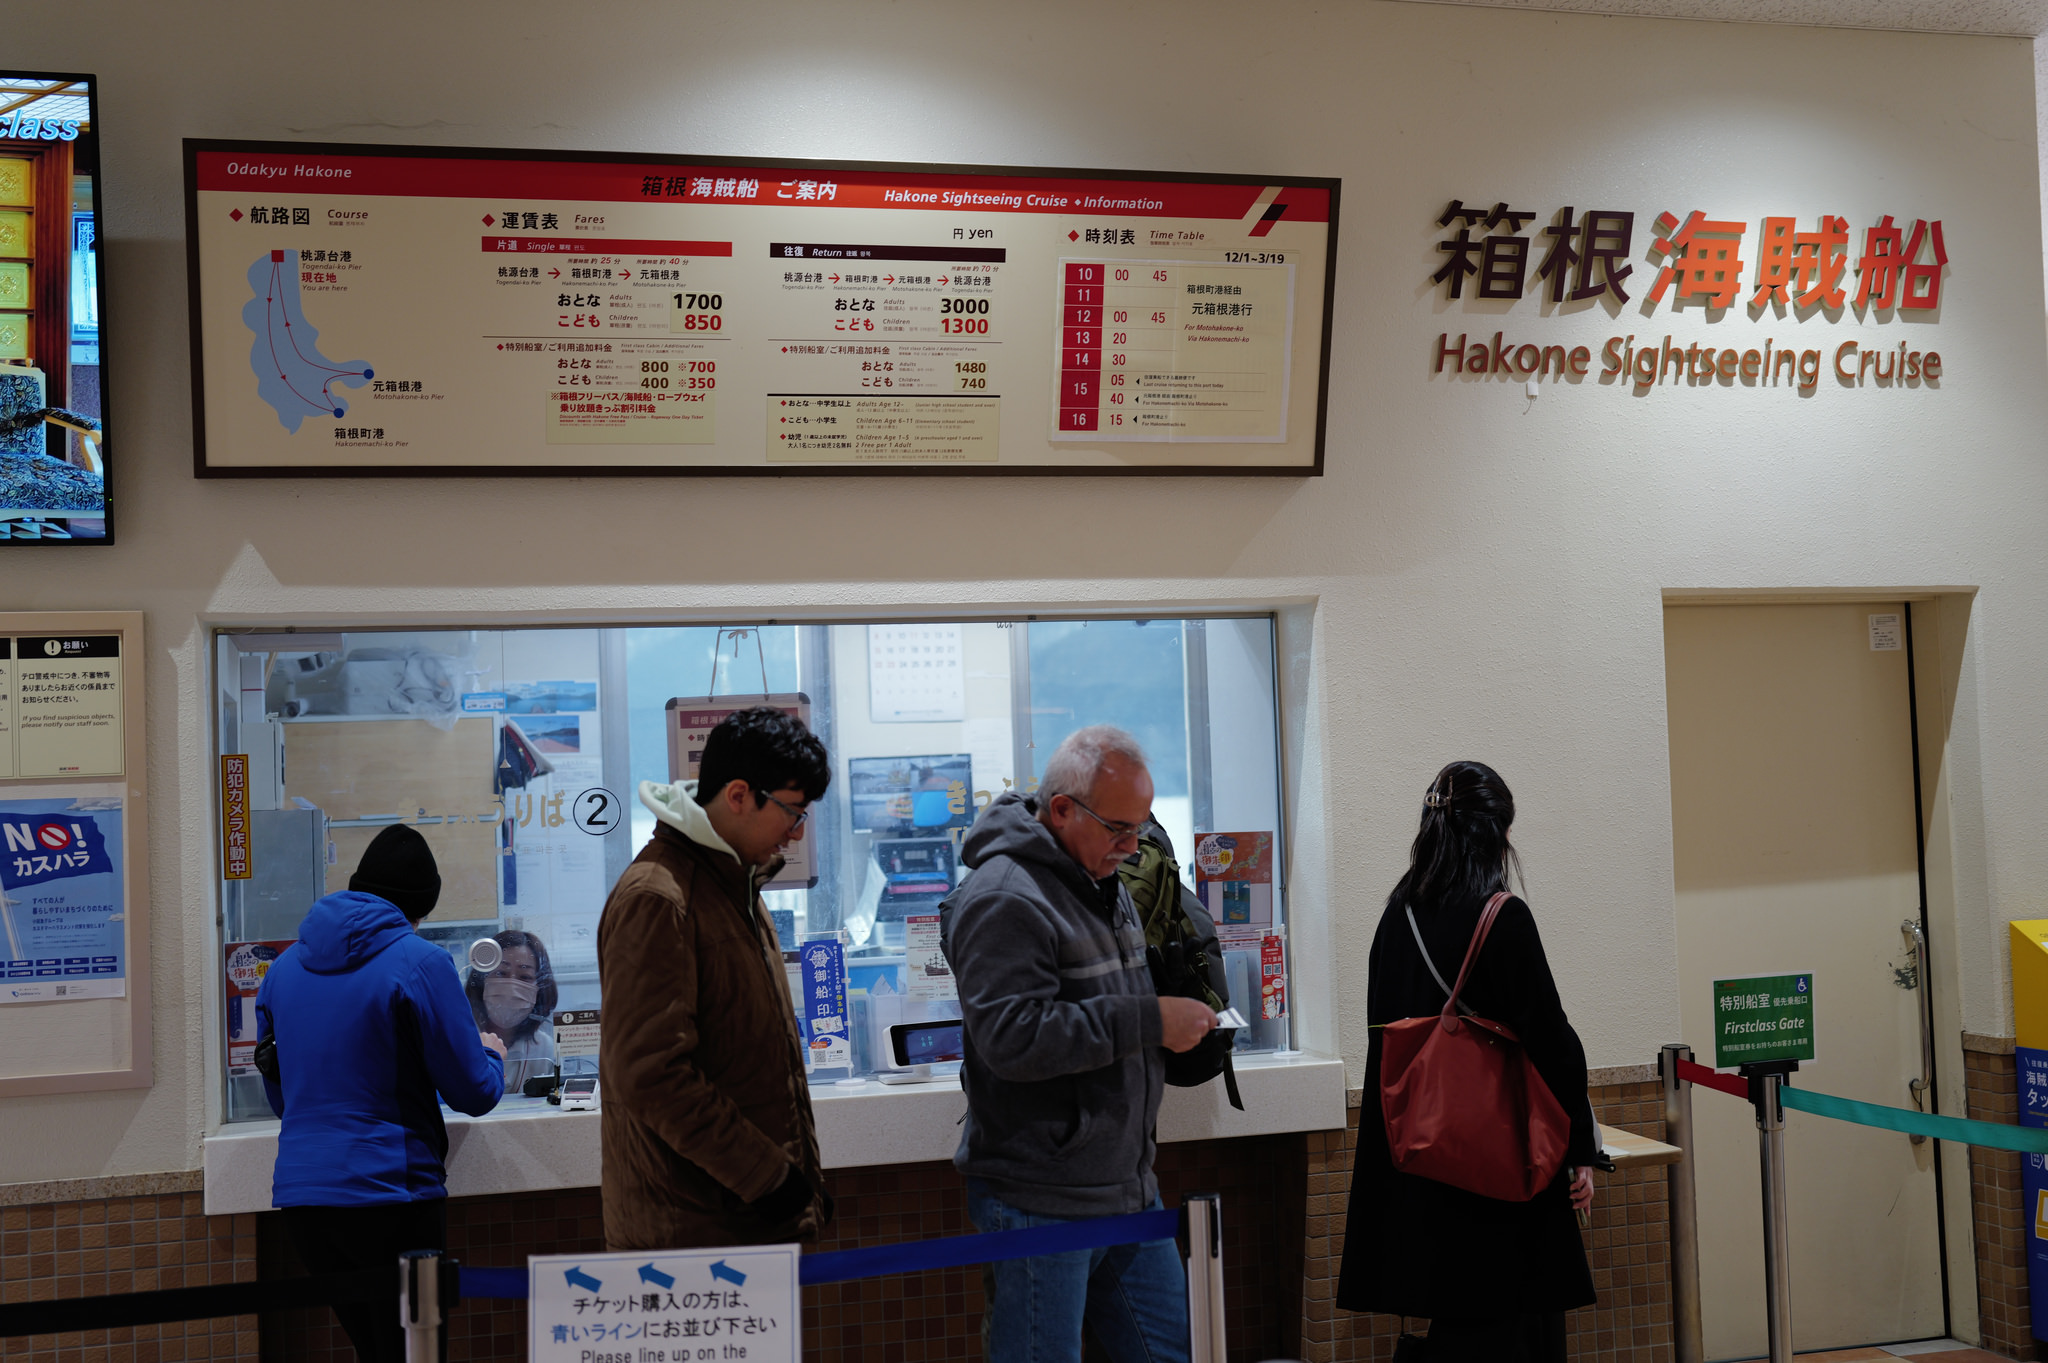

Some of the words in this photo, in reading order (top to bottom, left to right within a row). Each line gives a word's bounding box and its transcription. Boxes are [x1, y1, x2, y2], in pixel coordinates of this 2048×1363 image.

[227, 162, 288, 178] Odakyu
[293, 164, 353, 178] Hakone
[641, 175, 760, 200] 箱根海賊船
[775, 179, 838, 202] ご案内
[884, 188, 938, 205] Hakone
[941, 190, 1022, 209] Sightseeing
[1026, 193, 1069, 208] Cruise
[1083, 195, 1164, 211] Information
[249, 206, 311, 226] 航路図
[327, 208, 369, 220] Course
[501, 211, 559, 230] 運賃表
[574, 213, 605, 224] Fares
[952, 228, 964, 240] 円
[968, 228, 994, 241] yen
[1085, 228, 1136, 246] 時刻表
[1149, 230, 1174, 240] Time
[1177, 231, 1206, 241] Table
[497, 240, 518, 251] 片道
[526, 242, 556, 252] Single
[784, 246, 804, 257] 往復
[812, 248, 842, 258] Return
[301, 250, 352, 262] 桃源台港
[600, 256, 612, 265] 25
[668, 257, 680, 265] 40
[1224, 251, 1286, 265] 12/1~3/19
[1431, 199, 1949, 311] 箱根海賊船
[302, 263, 347, 272] Togendai-ko
[348, 263, 363, 271] Pier
[498, 267, 540, 278] 桃源台港
[571, 268, 612, 280] 箱根町港
[640, 269, 680, 281] 元箱根港
[301, 271, 338, 283] 現在地
[784, 272, 823, 283] 桃源台港
[845, 274, 879, 284] 箱根町港
[898, 275, 932, 285] 元箱根港
[953, 276, 992, 287] 桃源台港
[1078, 268, 1093, 281] 10
[1114, 269, 1130, 282] 00
[1152, 270, 1168, 282] 45
[302, 284, 315, 292] You
[330, 284, 349, 292] here
[1187, 284, 1242, 296] 箱根町港経由
[557, 293, 601, 308] おとな
[1077, 288, 1091, 302] 11
[672, 293, 724, 311] 1700
[834, 298, 876, 312] おとな
[883, 298, 906, 306] Adults
[940, 298, 990, 315] 3000
[1191, 302, 1253, 317] 元箱根港行
[557, 313, 601, 328] こども
[684, 314, 723, 332] 850
[1077, 310, 1091, 323] 12
[1113, 311, 1128, 323] 00
[1151, 312, 1166, 324] 45
[834, 318, 875, 332] こども
[882, 318, 911, 326] Children
[940, 318, 989, 334] 1300
[1196, 324, 1244, 332] Motohakone-ko
[1076, 332, 1090, 345] 13
[1112, 333, 1127, 345] 20
[505, 342, 613, 353] 特別船室/ご利用追加料金
[557, 358, 592, 370] おとな
[1075, 353, 1090, 366] 14
[1111, 354, 1126, 366] 30
[1436, 330, 1591, 377] Hakone
[1600, 333, 1823, 389] Sightseeing
[1833, 339, 1943, 381] Cruise
[640, 361, 669, 373] 800
[861, 361, 895, 372] おとな
[954, 362, 987, 374] 1480
[373, 380, 423, 393] 元箱根港
[557, 374, 592, 386] こども
[640, 377, 669, 389] 400
[861, 377, 894, 388] こども
[960, 378, 987, 390] 740
[1074, 382, 1088, 395] 15
[1111, 374, 1125, 387] 05
[373, 393, 430, 401] Motohakone-ko
[1110, 393, 1124, 405] 40
[855, 417, 883, 425] Children
[1072, 413, 1087, 426] 16
[1109, 414, 1123, 426] 15
[335, 428, 385, 440] 箱根町港
[787, 433, 802, 441] 幼児
[335, 440, 394, 448] Hakonemachi-ko
[62, 640, 90, 650] お願い
[21, 682, 116, 692] ありましたらお近くの係員まで
[22, 695, 79, 704] お知らせください。
[57, 714, 90, 722] suspicious
[43, 721, 63, 729] notify
[226, 757, 248, 877] 防犯カメラ作動中
[13, 850, 91, 878] カスハラ
[814, 968, 831, 1018] 御船印
[1720, 993, 1771, 1012] 特別船室
[1724, 1019, 1777, 1035] Firstclass
[1779, 1017, 1806, 1030] Gate
[572, 1290, 750, 1316] チケット購入の方は、
[550, 1316, 777, 1344] 青いラインにお並び下さい
[581, 1349, 632, 1363] Please
[639, 1347, 665, 1363] line
[672, 1349, 690, 1363] up
[697, 1347, 716, 1361] on
[723, 1344, 748, 1360] the
